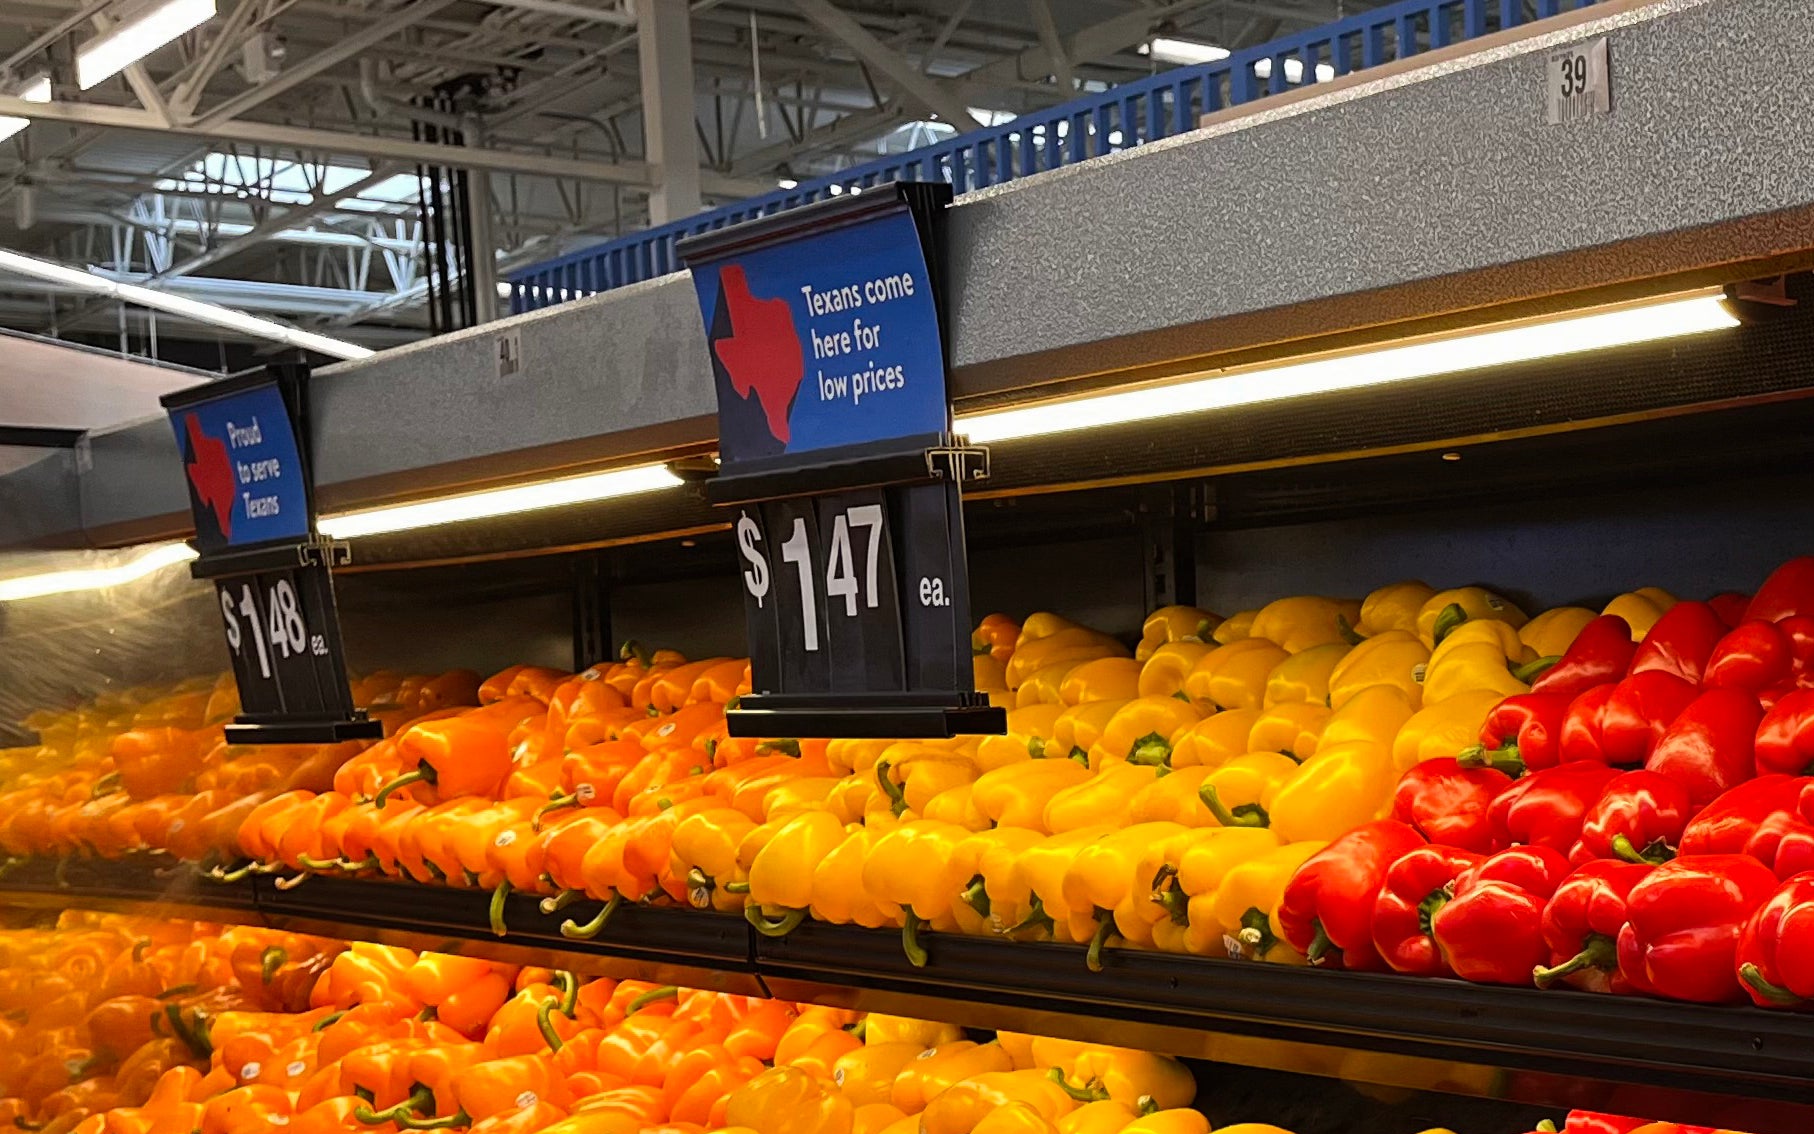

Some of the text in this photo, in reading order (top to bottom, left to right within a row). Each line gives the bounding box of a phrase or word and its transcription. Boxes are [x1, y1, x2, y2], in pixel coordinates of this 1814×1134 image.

[1561, 54, 1587, 98] 39
[801, 271, 915, 318] Texans come
[811, 318, 881, 360] here for
[818, 360, 905, 406] low prices
[226, 416, 263, 450] Proud
[237, 456, 281, 485] to serve
[242, 491, 281, 520] Texans
[919, 576, 951, 607] ea.
[311, 633, 329, 657] ea.
